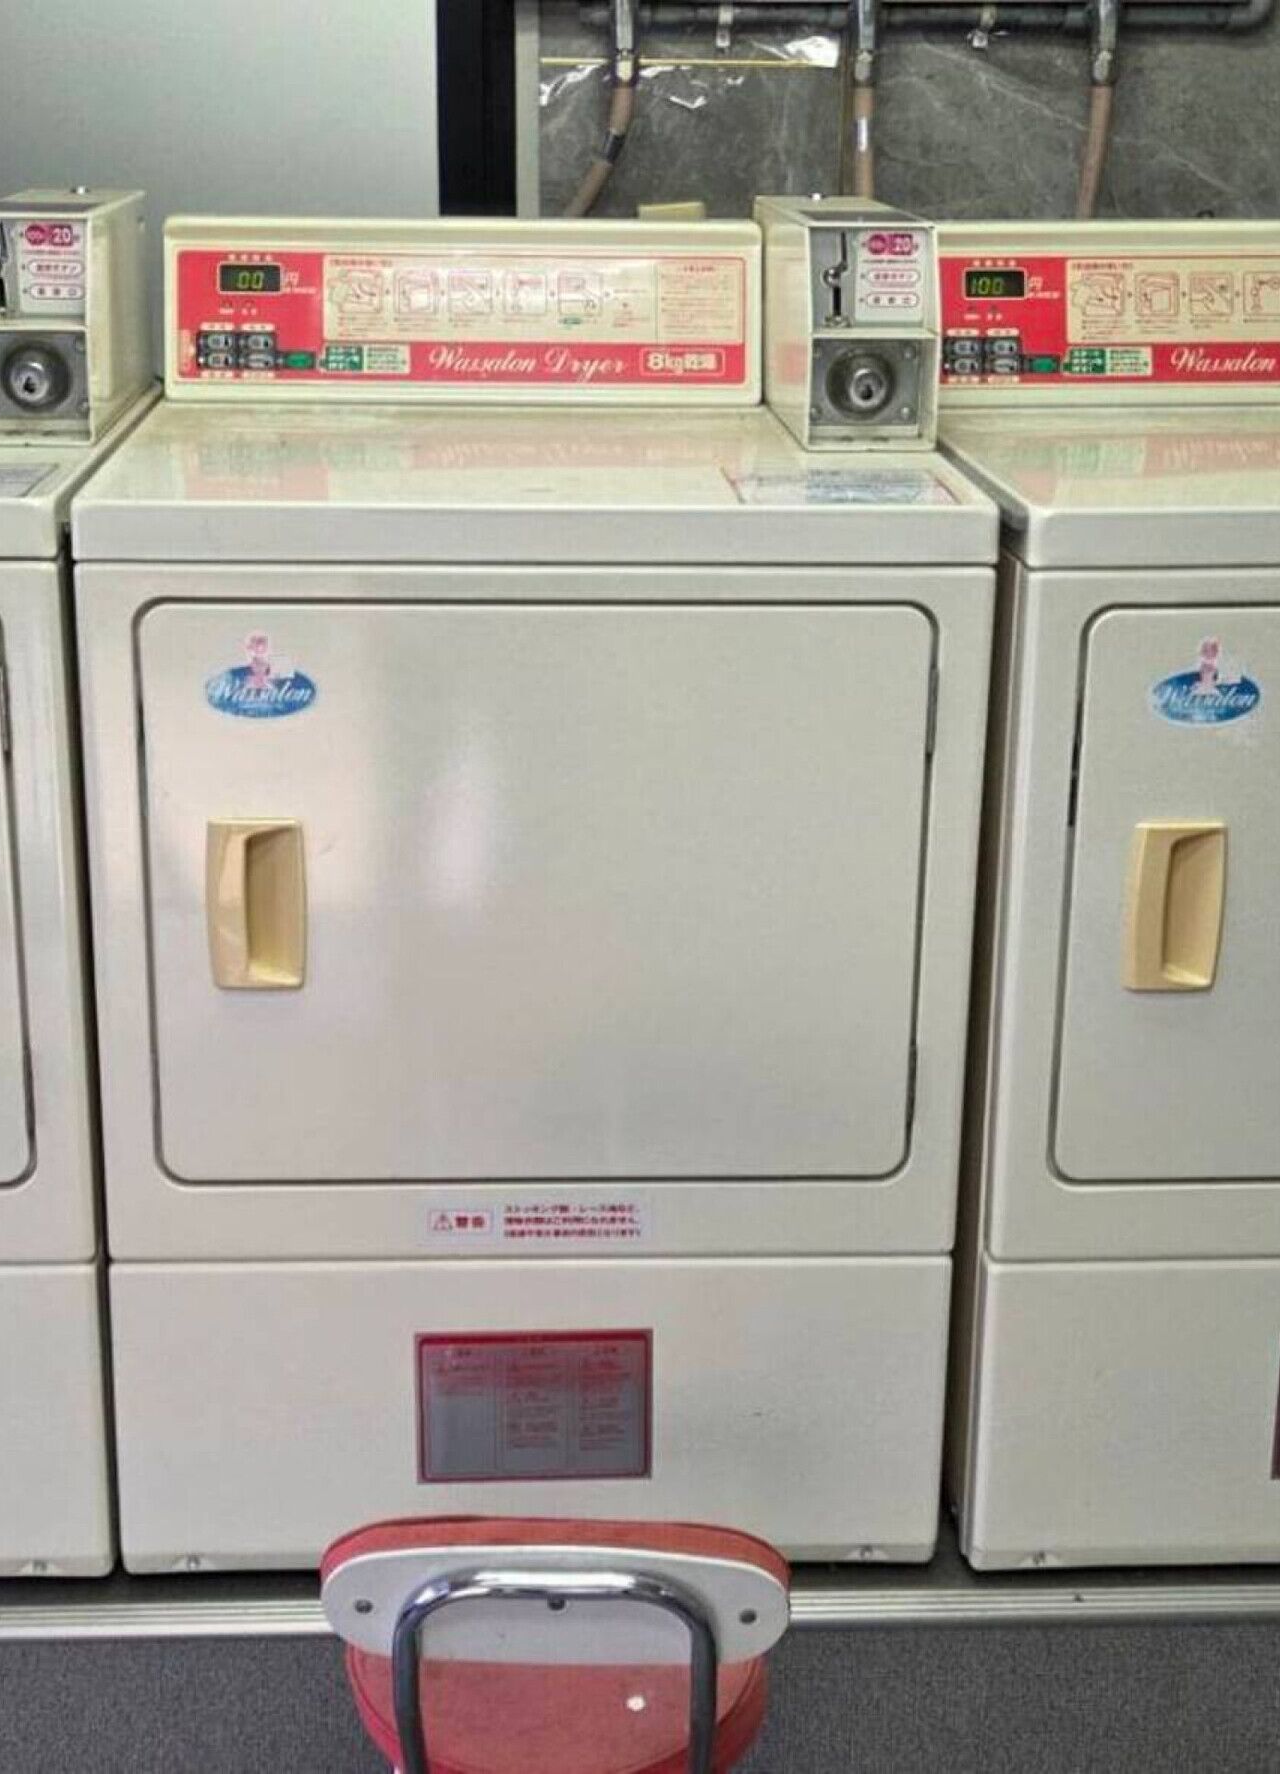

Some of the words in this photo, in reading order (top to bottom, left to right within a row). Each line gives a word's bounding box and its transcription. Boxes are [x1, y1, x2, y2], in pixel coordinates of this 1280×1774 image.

[429, 344, 536, 375] Wassalon
[547, 345, 627, 382] Dryer
[1171, 347, 1276, 376] Wassalon
